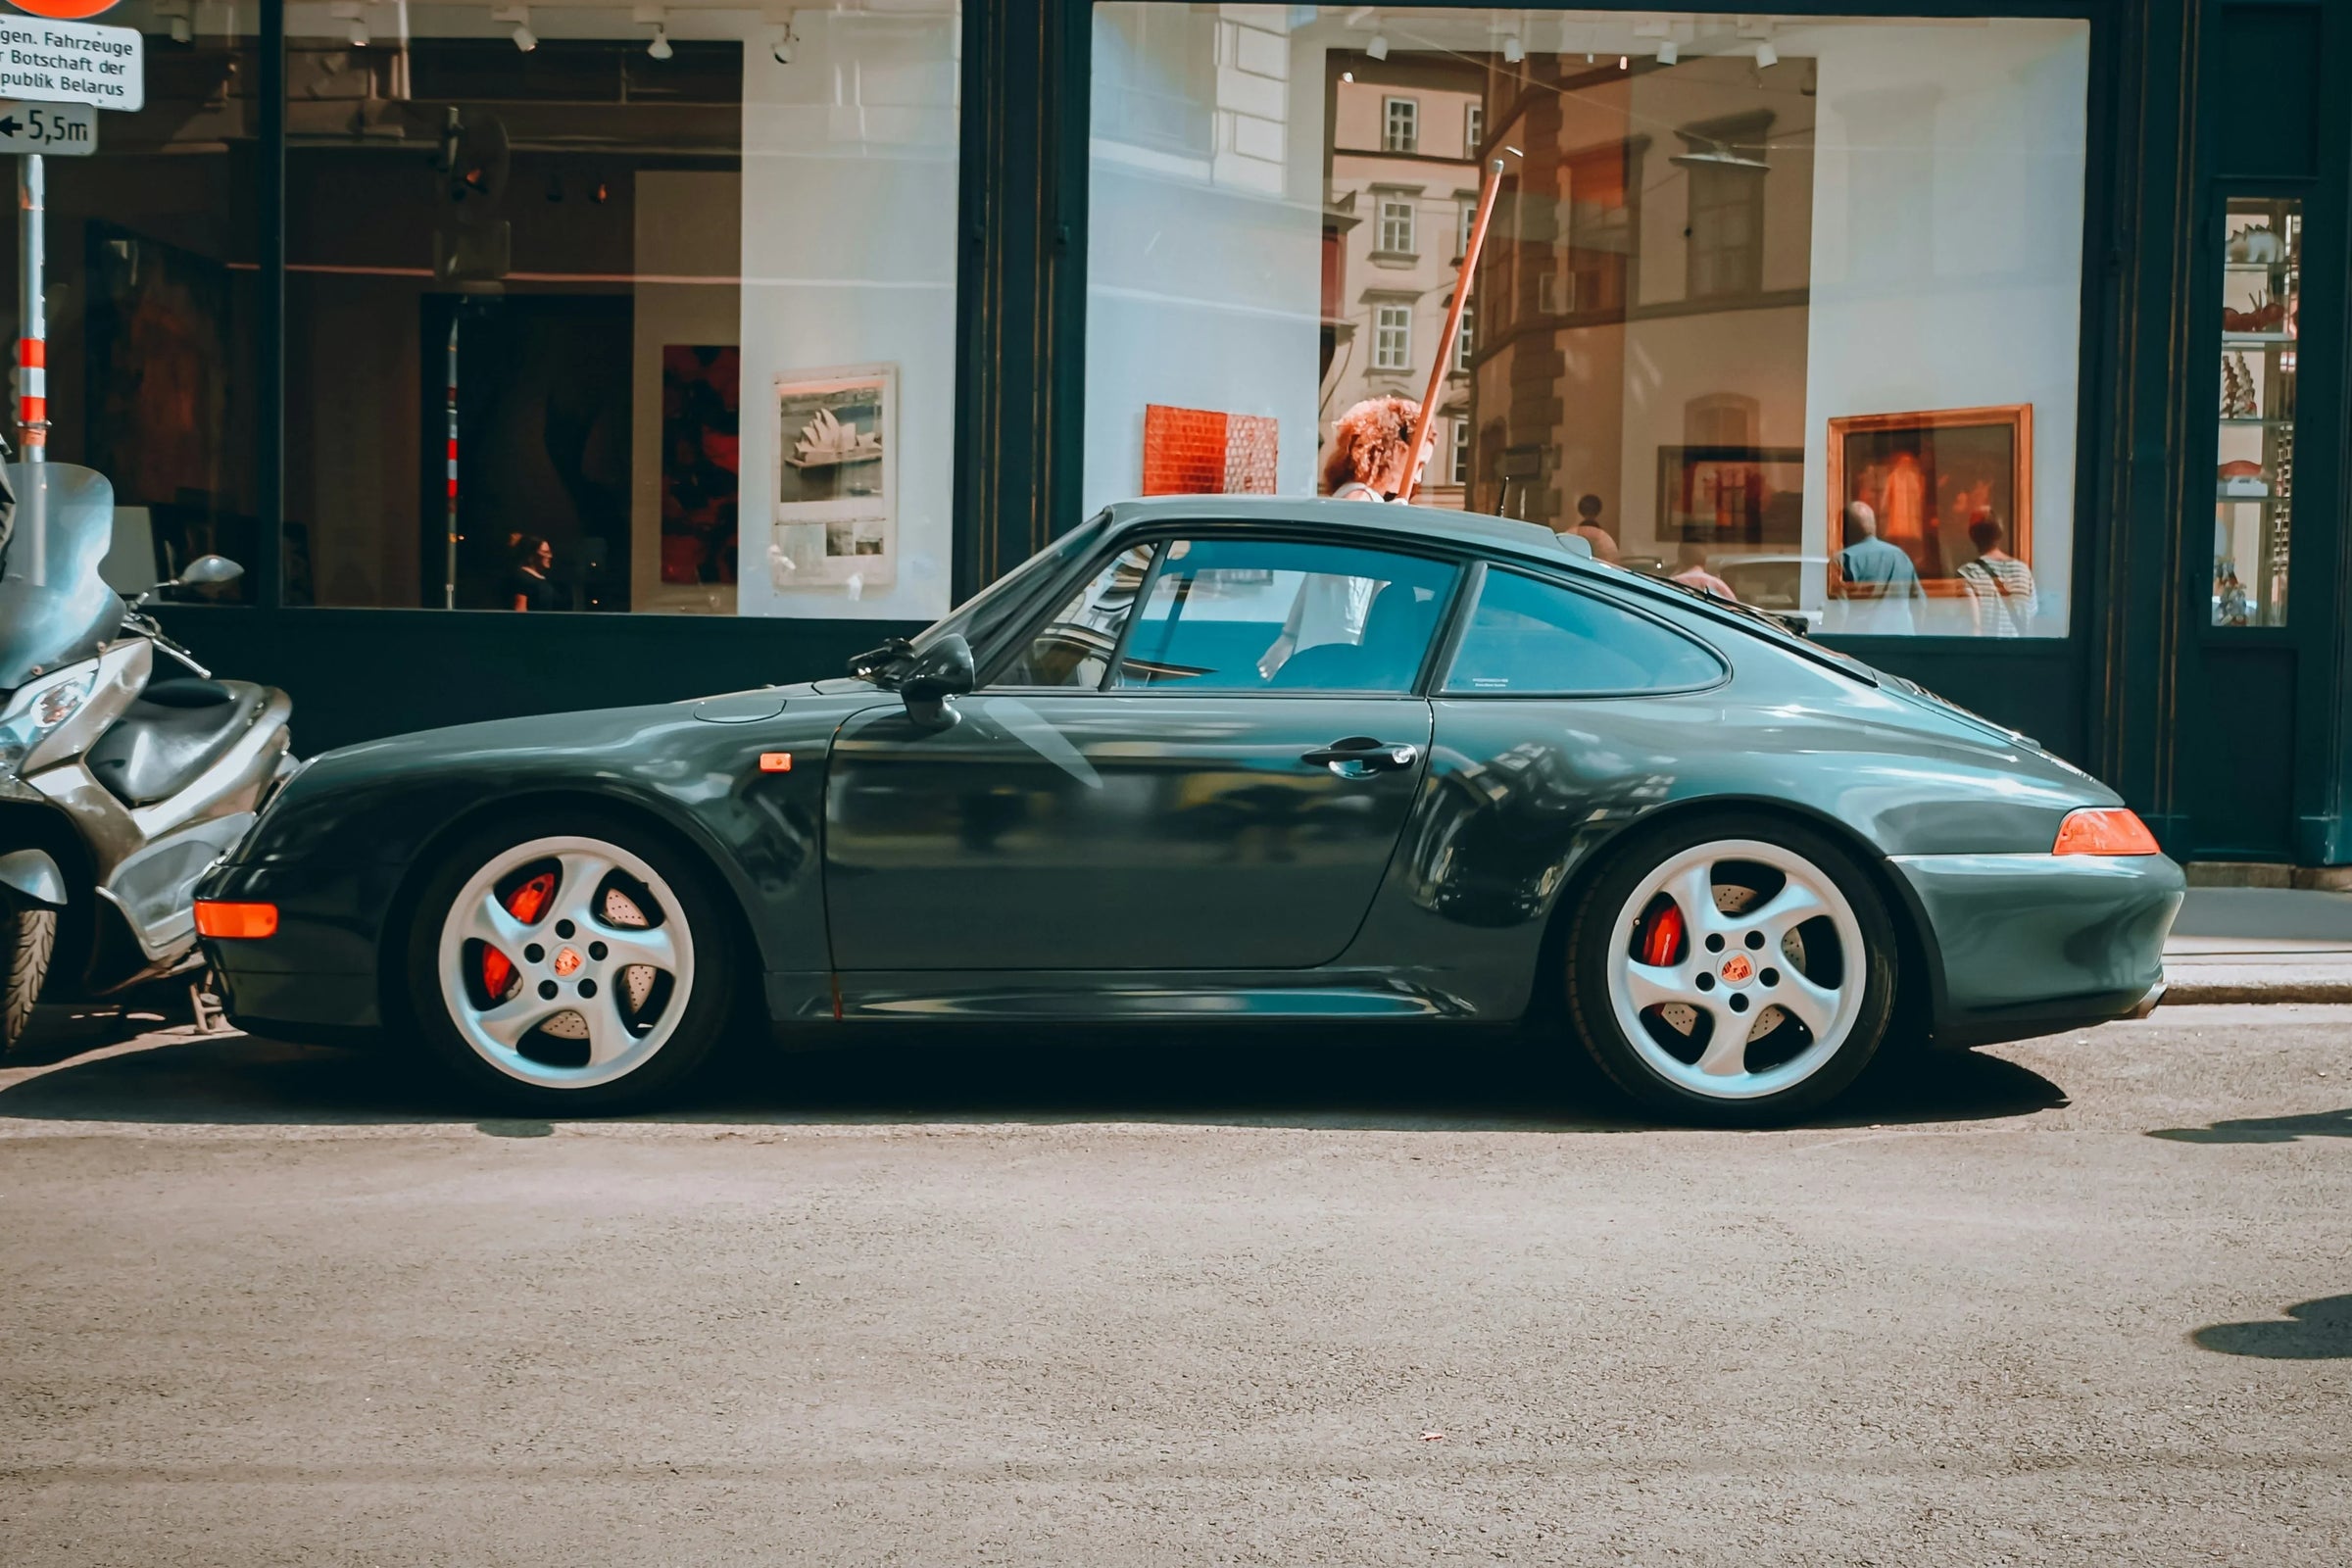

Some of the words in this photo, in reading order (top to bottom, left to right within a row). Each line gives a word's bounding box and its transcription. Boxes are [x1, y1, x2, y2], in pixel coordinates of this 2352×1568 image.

[44, 31, 133, 57] Fahrzeuge
[11, 49, 93, 73] Botschaft
[99, 60, 125, 75] der
[1, 72, 55, 89] publik
[60, 76, 124, 96] Belarus
[28, 110, 88, 145] 5,5m
